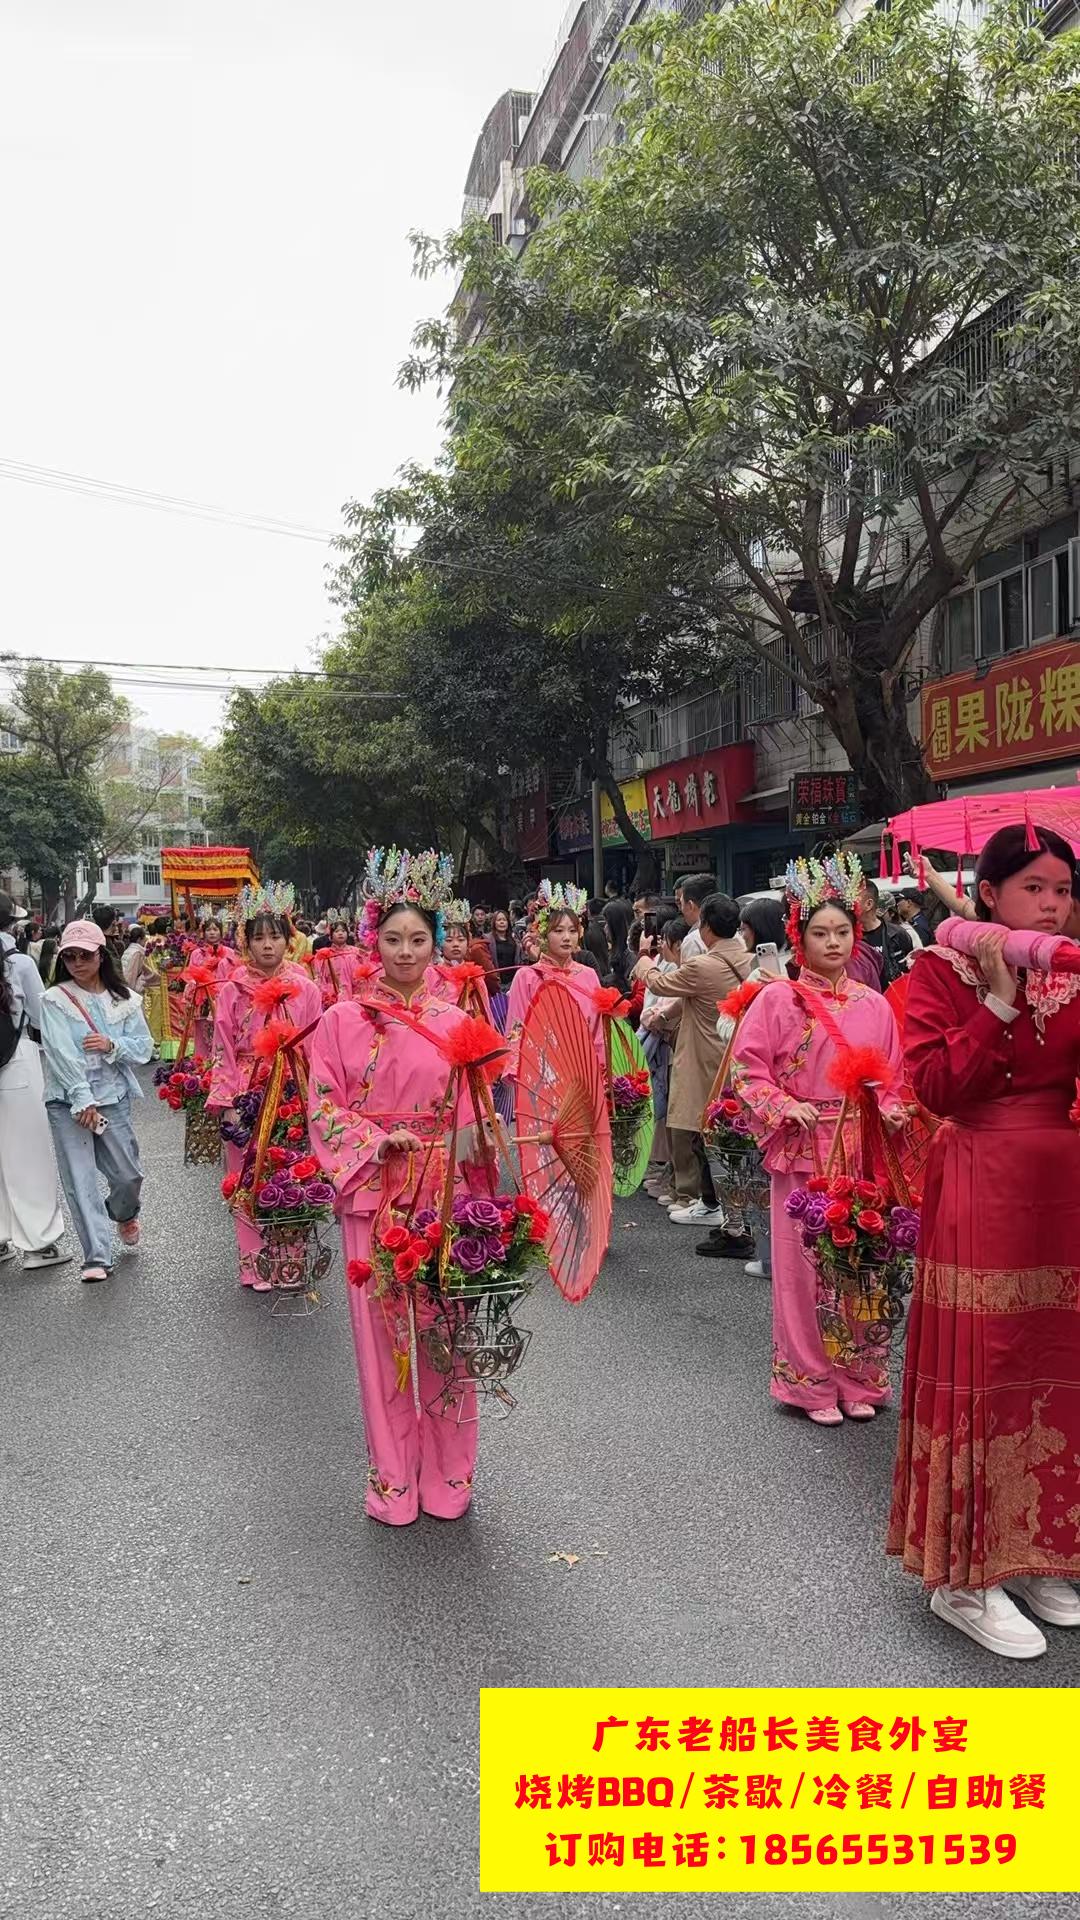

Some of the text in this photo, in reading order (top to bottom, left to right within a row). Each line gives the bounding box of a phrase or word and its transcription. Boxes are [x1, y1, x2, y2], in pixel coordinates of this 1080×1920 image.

[934, 702, 949, 755] 庄记
[954, 662, 1080, 755] 果陇粿
